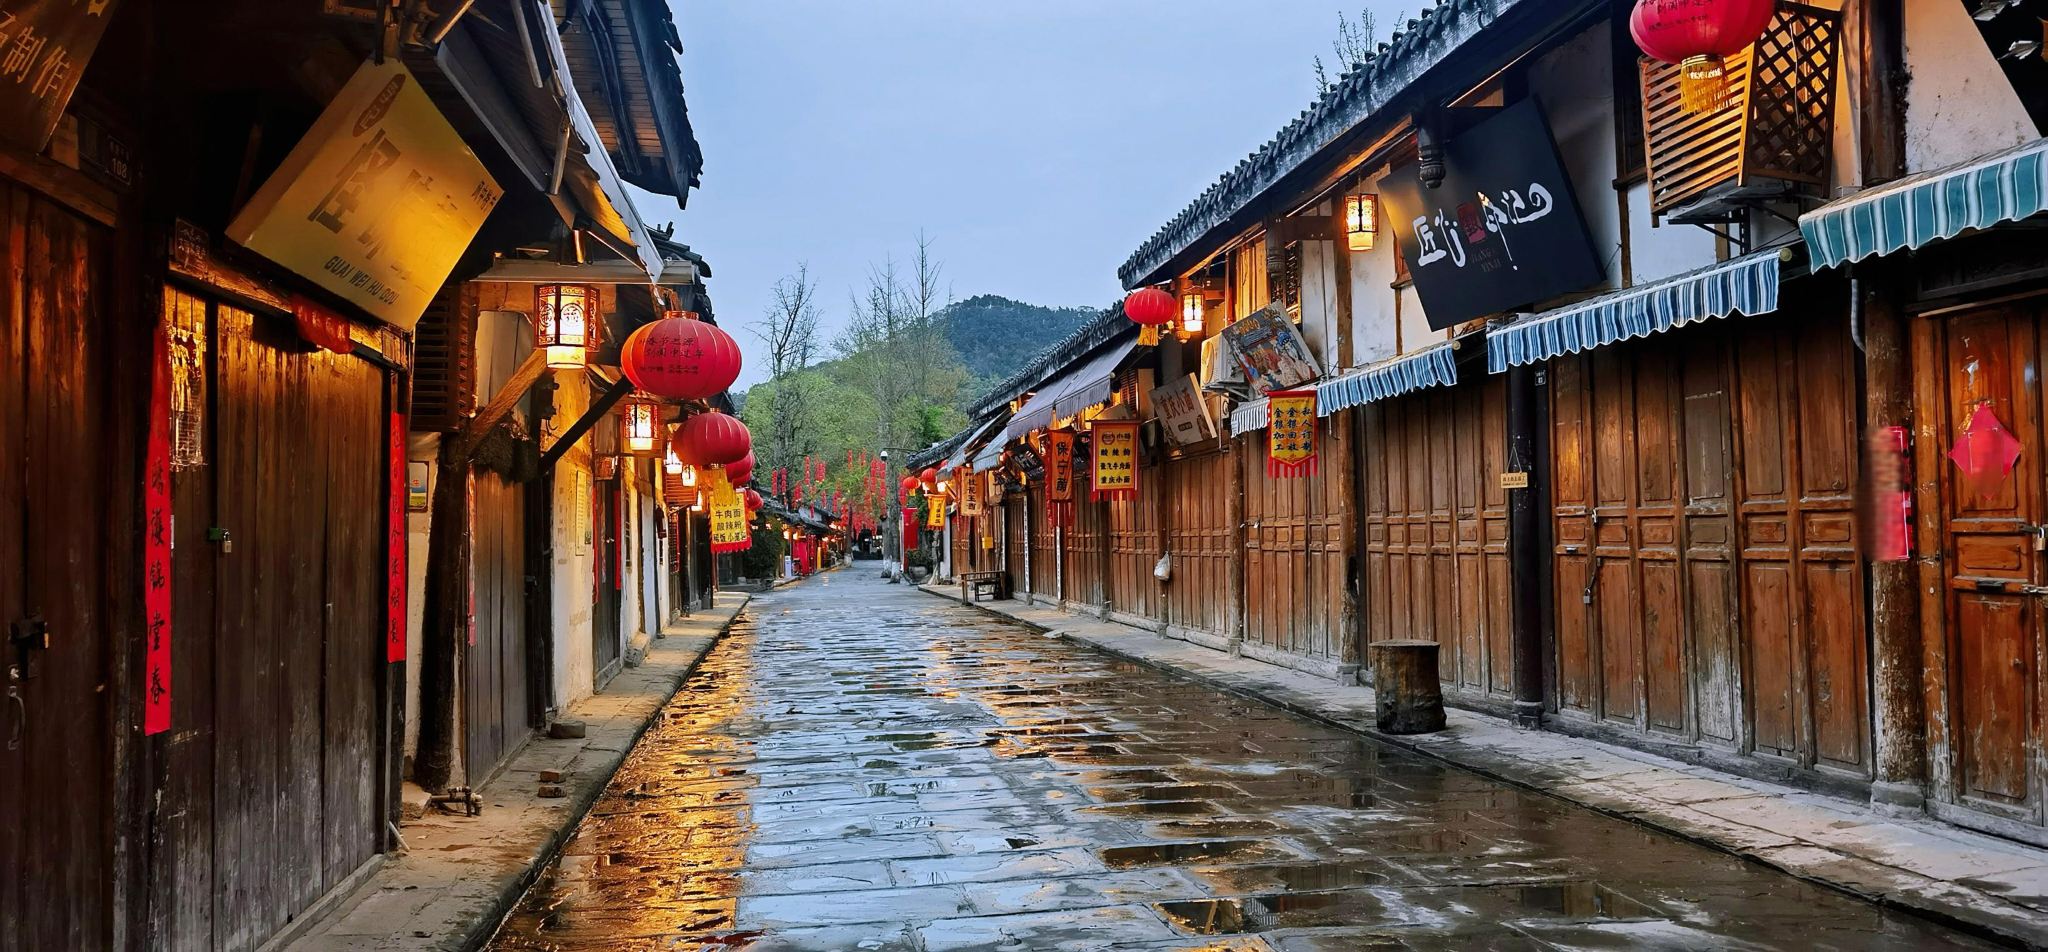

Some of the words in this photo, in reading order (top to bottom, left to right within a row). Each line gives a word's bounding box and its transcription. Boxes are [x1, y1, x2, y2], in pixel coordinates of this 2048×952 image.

[324, 255, 355, 279] GUAI
[349, 270, 372, 289] WEI
[366, 280, 385, 296] HU
[1055, 441, 1069, 492] 保宁醋
[1100, 475, 1131, 484] 重庆小面
[715, 508, 741, 519] 牛肉面
